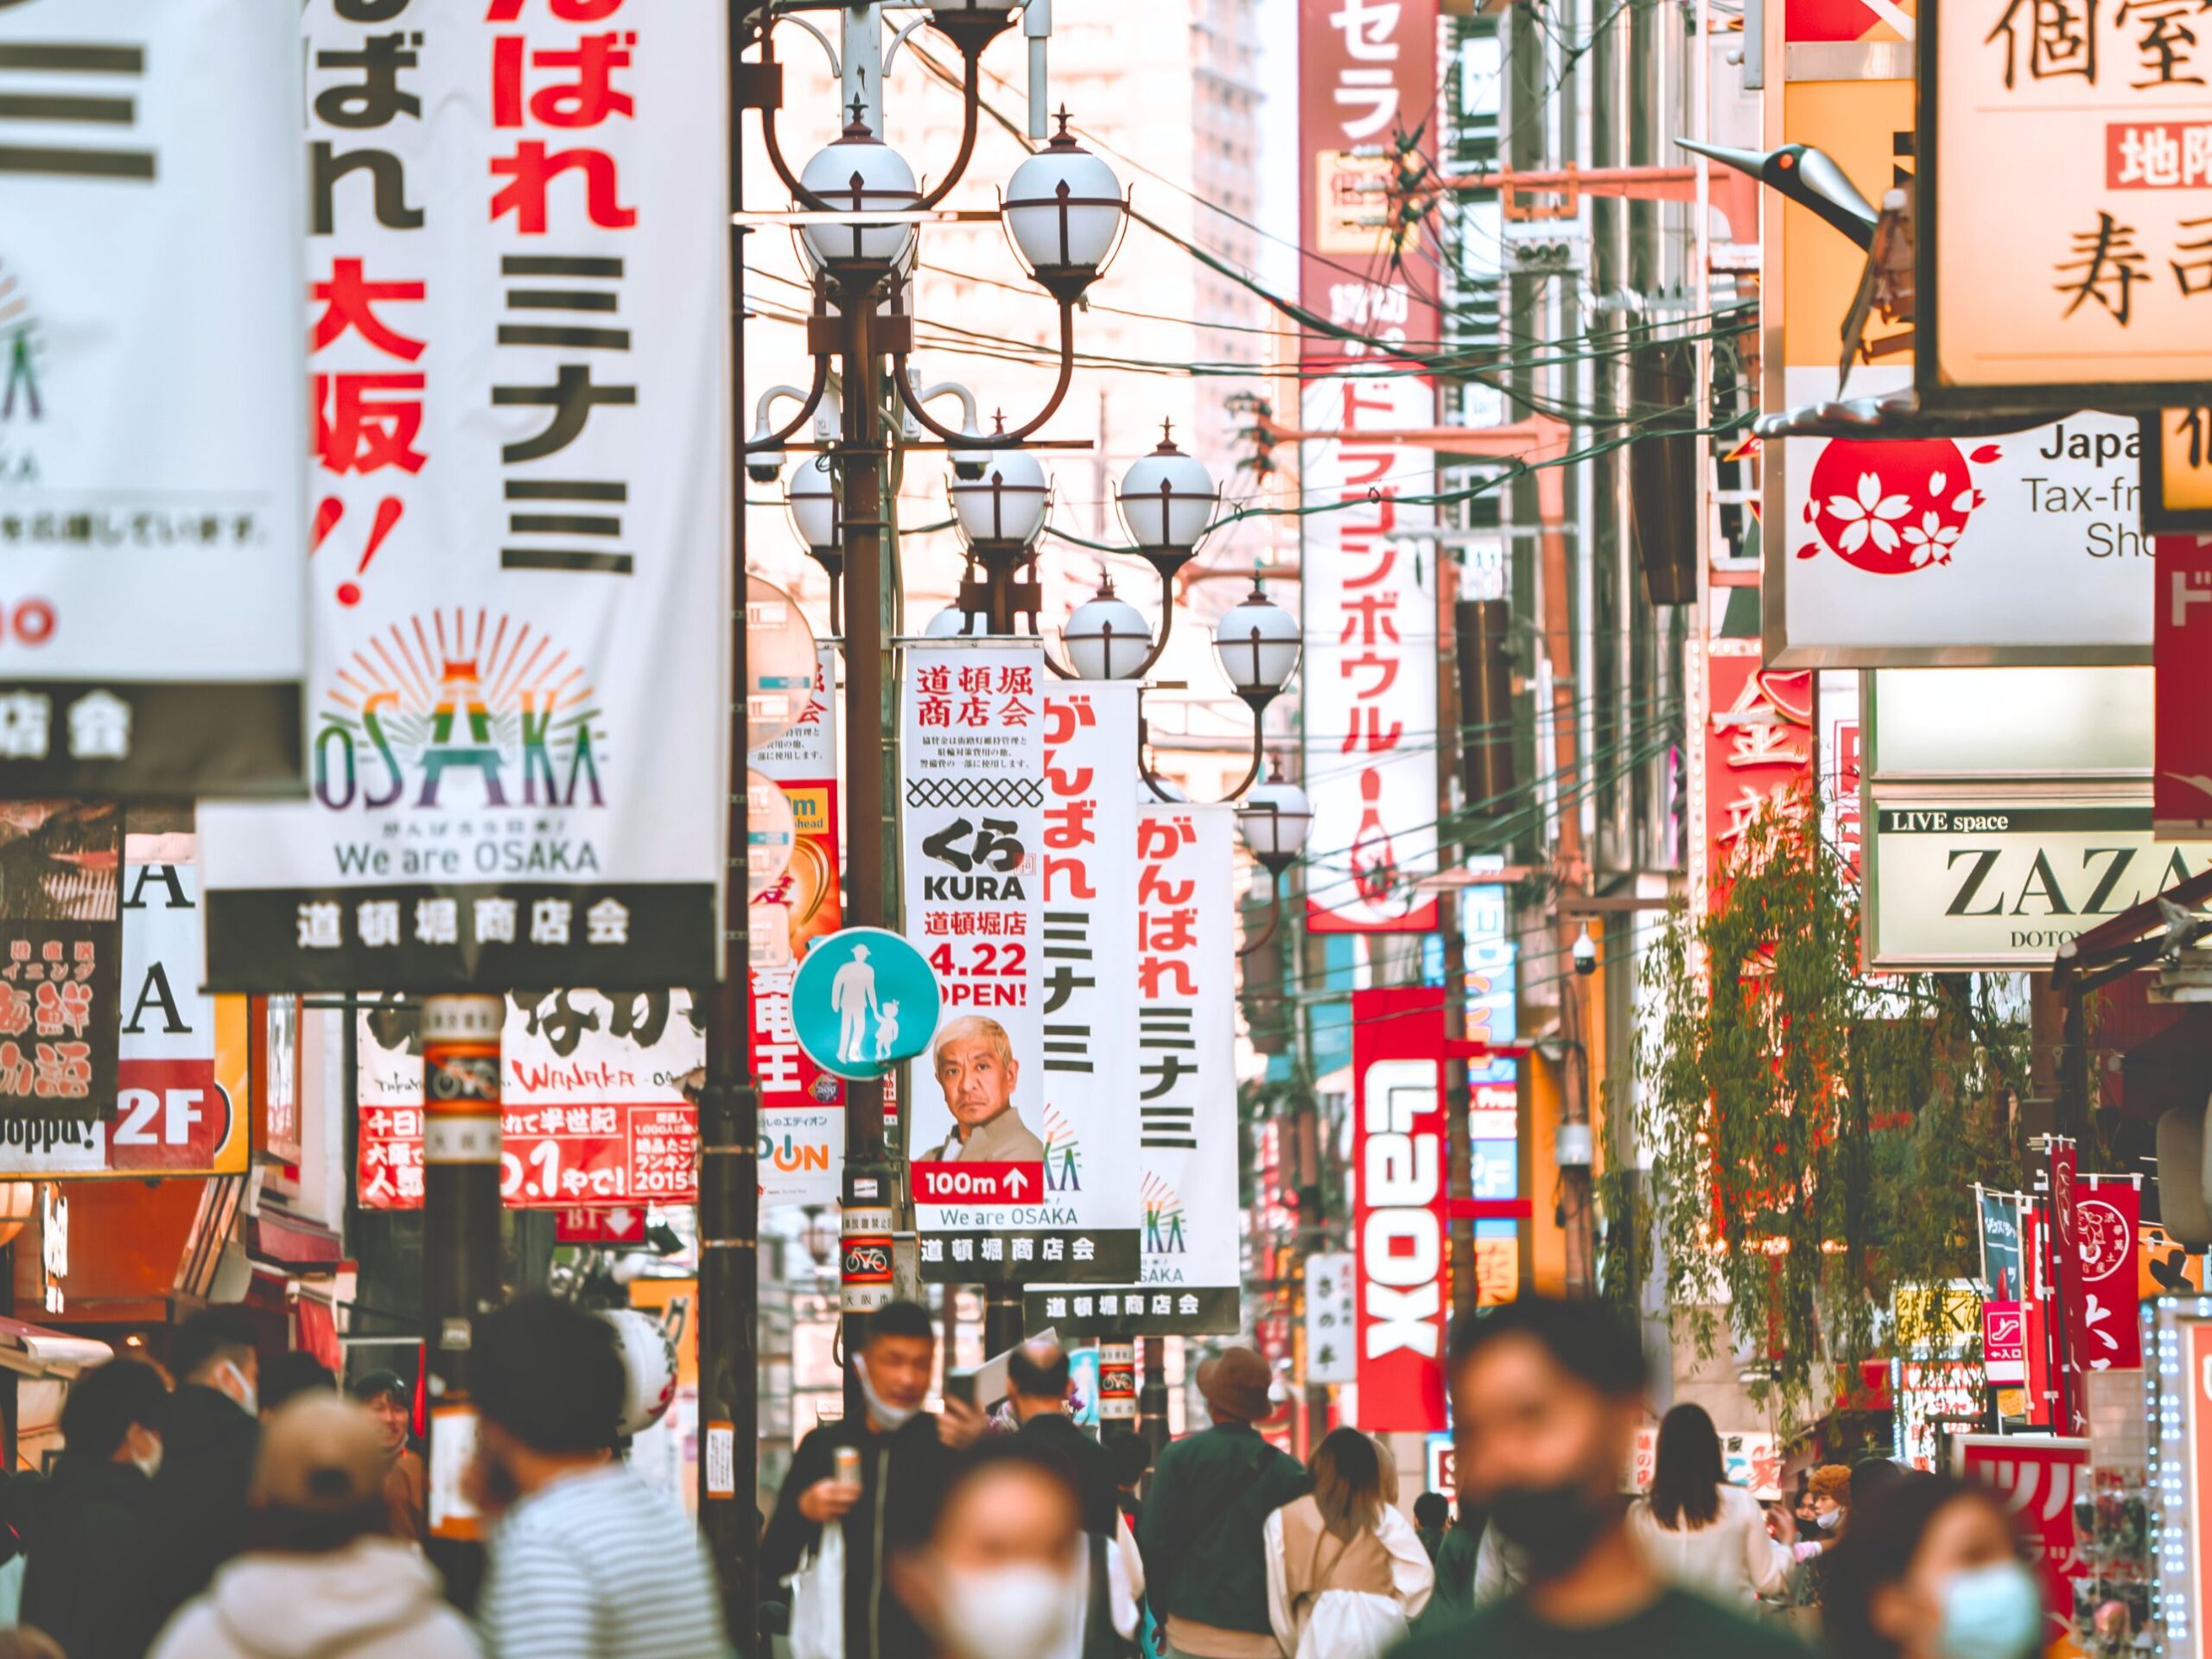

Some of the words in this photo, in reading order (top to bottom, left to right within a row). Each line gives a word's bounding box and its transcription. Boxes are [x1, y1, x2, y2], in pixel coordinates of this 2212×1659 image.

[484, 0, 641, 574] ばれミナミ
[916, 664, 1035, 696] 道頓堀
[916, 696, 1036, 728] 商店会
[315, 659, 608, 811] OSAKA
[1891, 812, 1948, 831] LIVE
[1953, 815, 2009, 833] space
[334, 843, 395, 875] We
[402, 849, 461, 874] are
[474, 840, 601, 874] OSAKA
[922, 817, 1026, 874] くら
[924, 876, 1027, 900] KURA
[296, 898, 630, 948] 道頓堀商店会
[925, 911, 1027, 936] 道頓堀店
[929, 943, 1027, 977] 4.22
[112, 1088, 204, 1146] 2F
[925, 1172, 996, 1195] 100m
[939, 1208, 969, 1226] We
[976, 1211, 1010, 1225] are
[1012, 1207, 1079, 1225] OSAKA
[921, 1236, 1096, 1262] 道頓堀商店会
[1046, 1293, 1200, 1319] 道頓堀商店会
[2000, 1347, 2023, 1360] 入口
